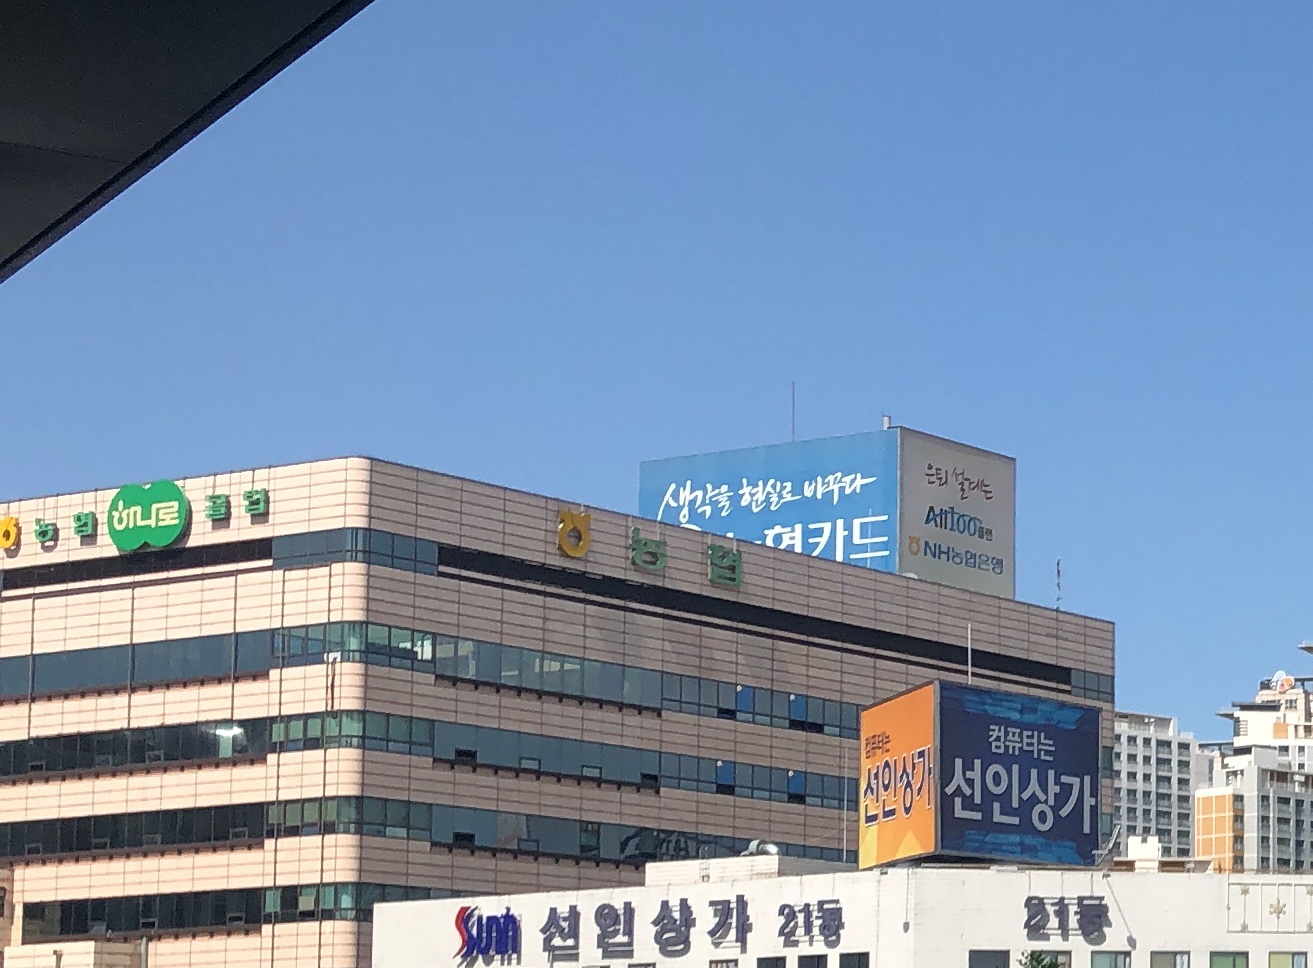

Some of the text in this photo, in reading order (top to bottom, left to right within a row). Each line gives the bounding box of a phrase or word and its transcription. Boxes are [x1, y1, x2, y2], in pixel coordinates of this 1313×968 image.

[657, 471, 877, 524] 생각을 현실로 바꾸다
[630, 526, 743, 588] 농협
[923, 540, 1005, 576] NH농협은행
[988, 724, 1056, 761] 컴퓨터는
[863, 745, 934, 828] 선인상가
[944, 757, 1096, 834] 선인상가
[539, 894, 749, 956] 선인상가
[778, 899, 845, 945] 21동
[1023, 895, 1111, 945] 21동
